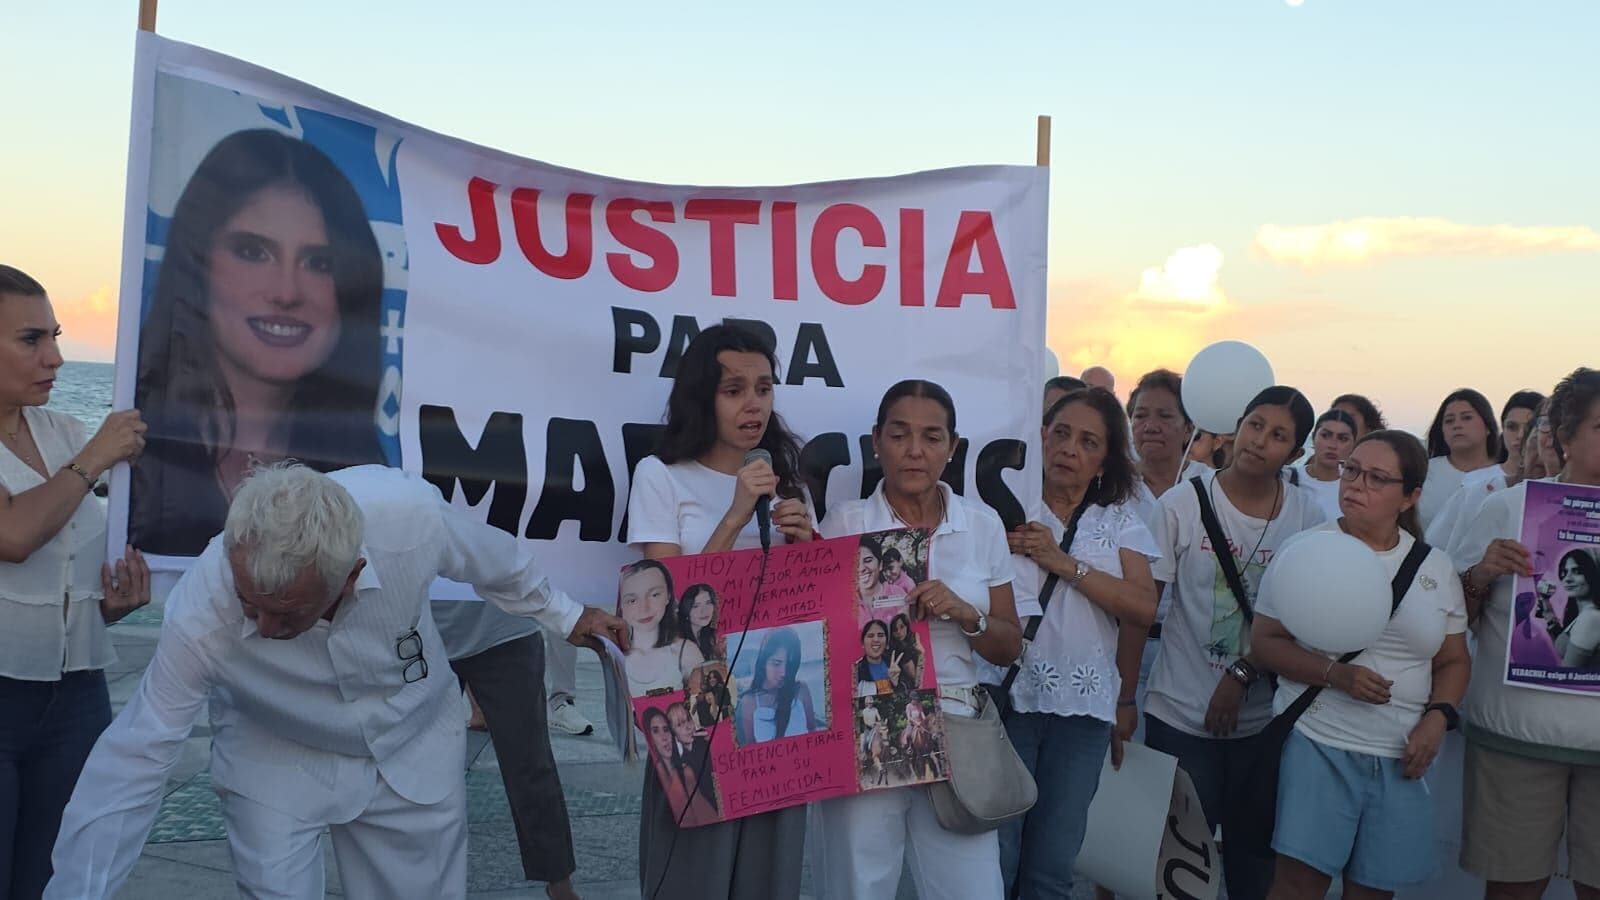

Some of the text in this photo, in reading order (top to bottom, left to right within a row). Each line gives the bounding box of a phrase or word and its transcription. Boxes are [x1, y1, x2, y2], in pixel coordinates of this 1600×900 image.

[433, 176, 1017, 310] JUSTICIA
[611, 305, 845, 388] PAA
[687, 554, 736, 579] ¡HOY
[784, 547, 834, 567] FALTA
[722, 562, 842, 593] MI MEJOR AMIGA
[716, 618, 732, 632] MI
[777, 593, 824, 617] MITAD!
[720, 583, 817, 613] MI HERMANA
[1511, 668, 1546, 678] VERACRUZ
[806, 731, 845, 750] FIRME
[741, 757, 811, 783] PARA SU
